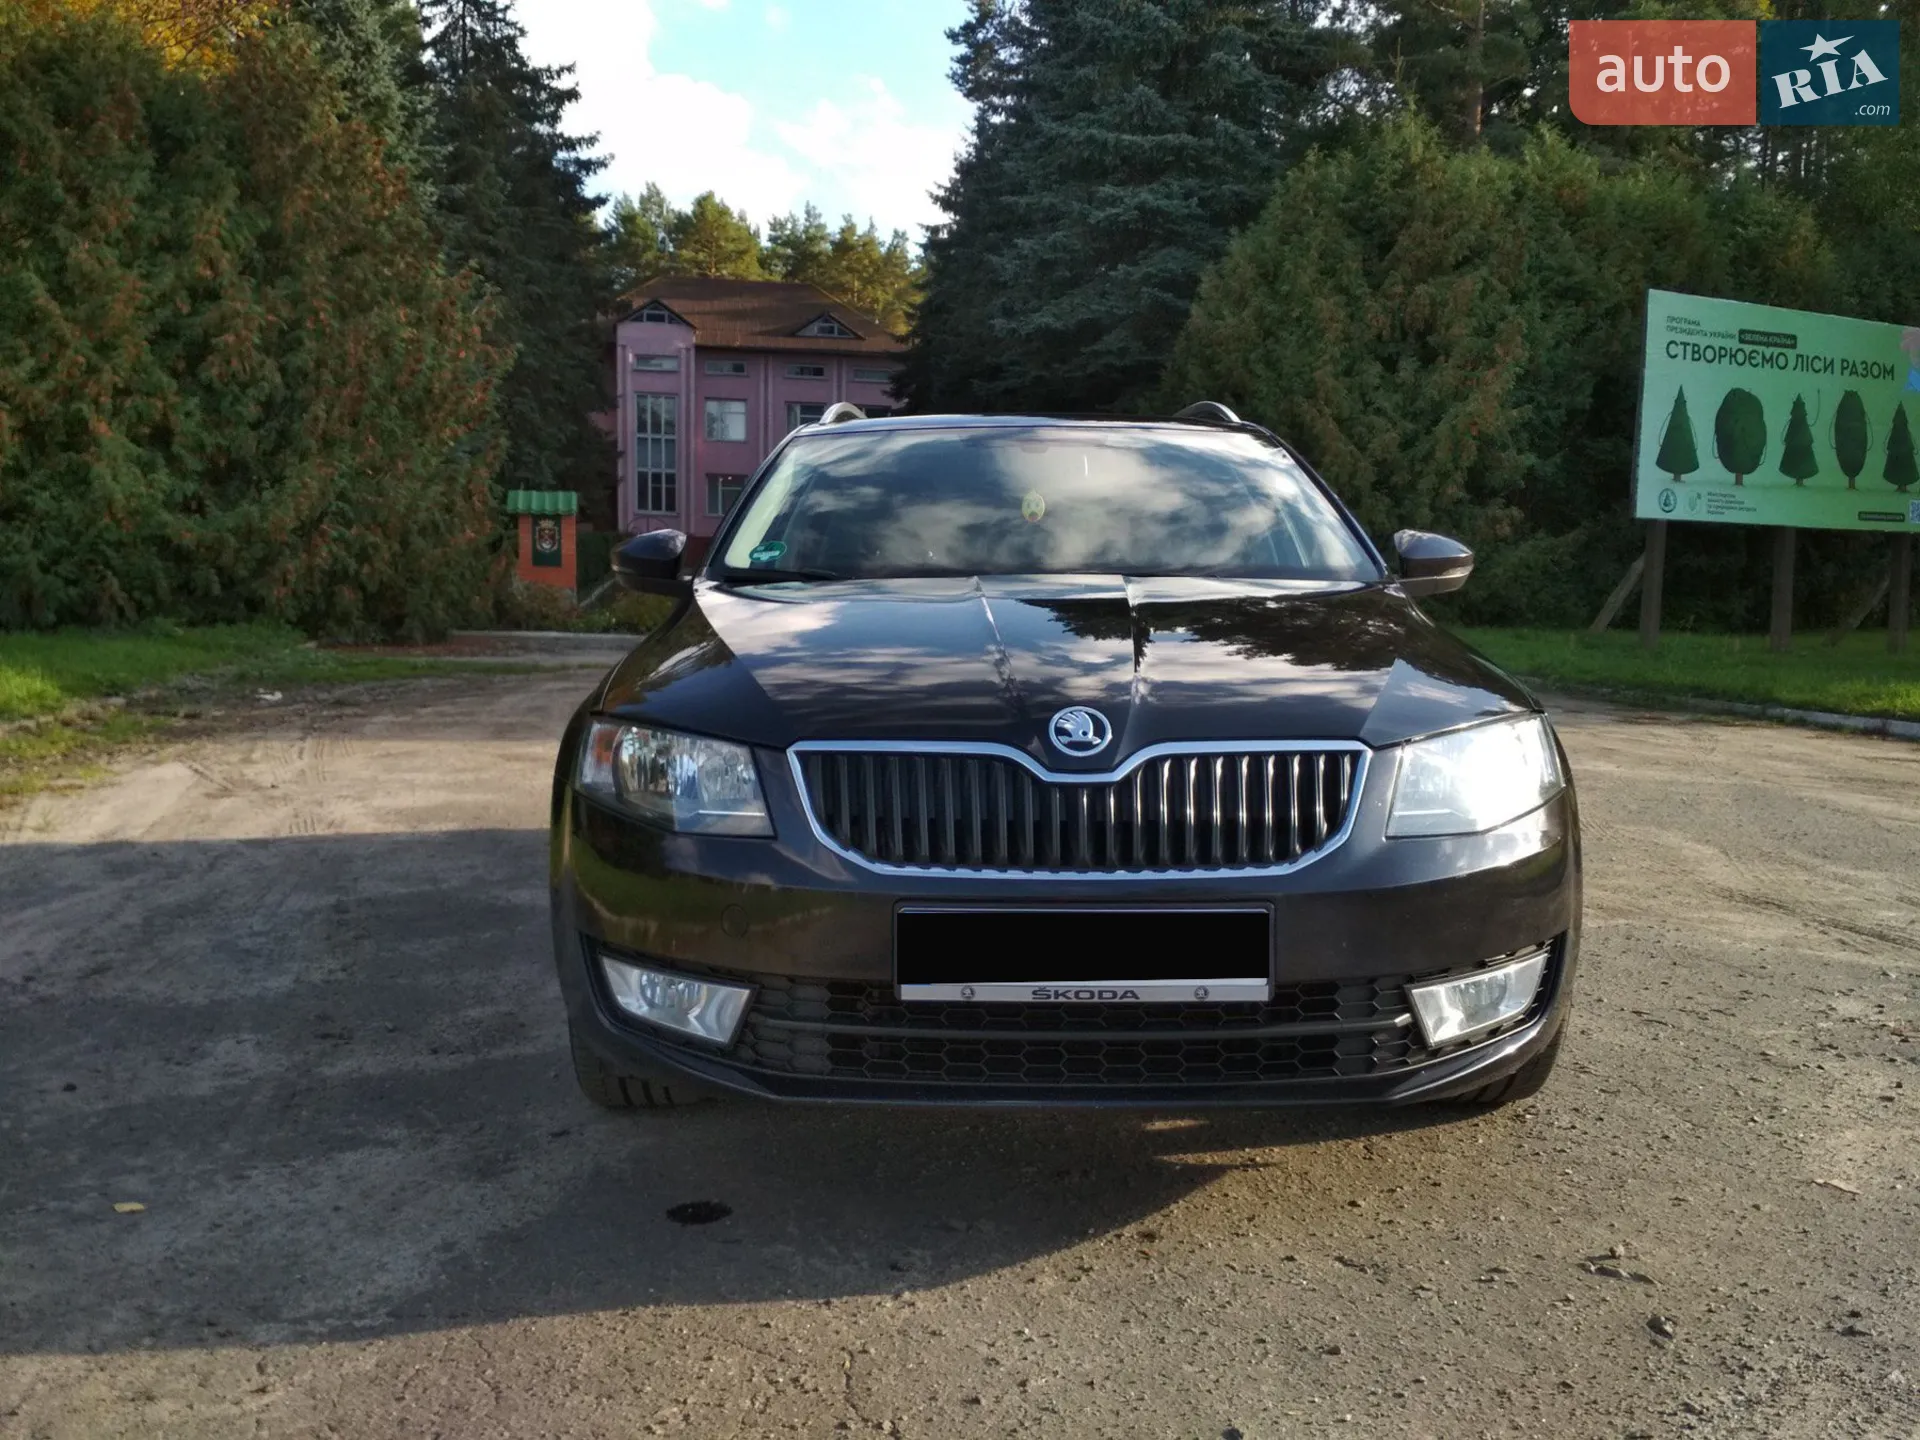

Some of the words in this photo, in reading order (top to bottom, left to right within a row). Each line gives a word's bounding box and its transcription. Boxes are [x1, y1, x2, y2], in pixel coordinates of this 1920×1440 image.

[1666, 315, 1701, 327] ПРОГРАМА
[1666, 340, 1788, 370] СТВОРЮЄМО
[1793, 353, 1835, 375] ЛІСИ
[1840, 359, 1895, 381] РАЗОМ
[1032, 986, 1140, 1000] ŠKODA
